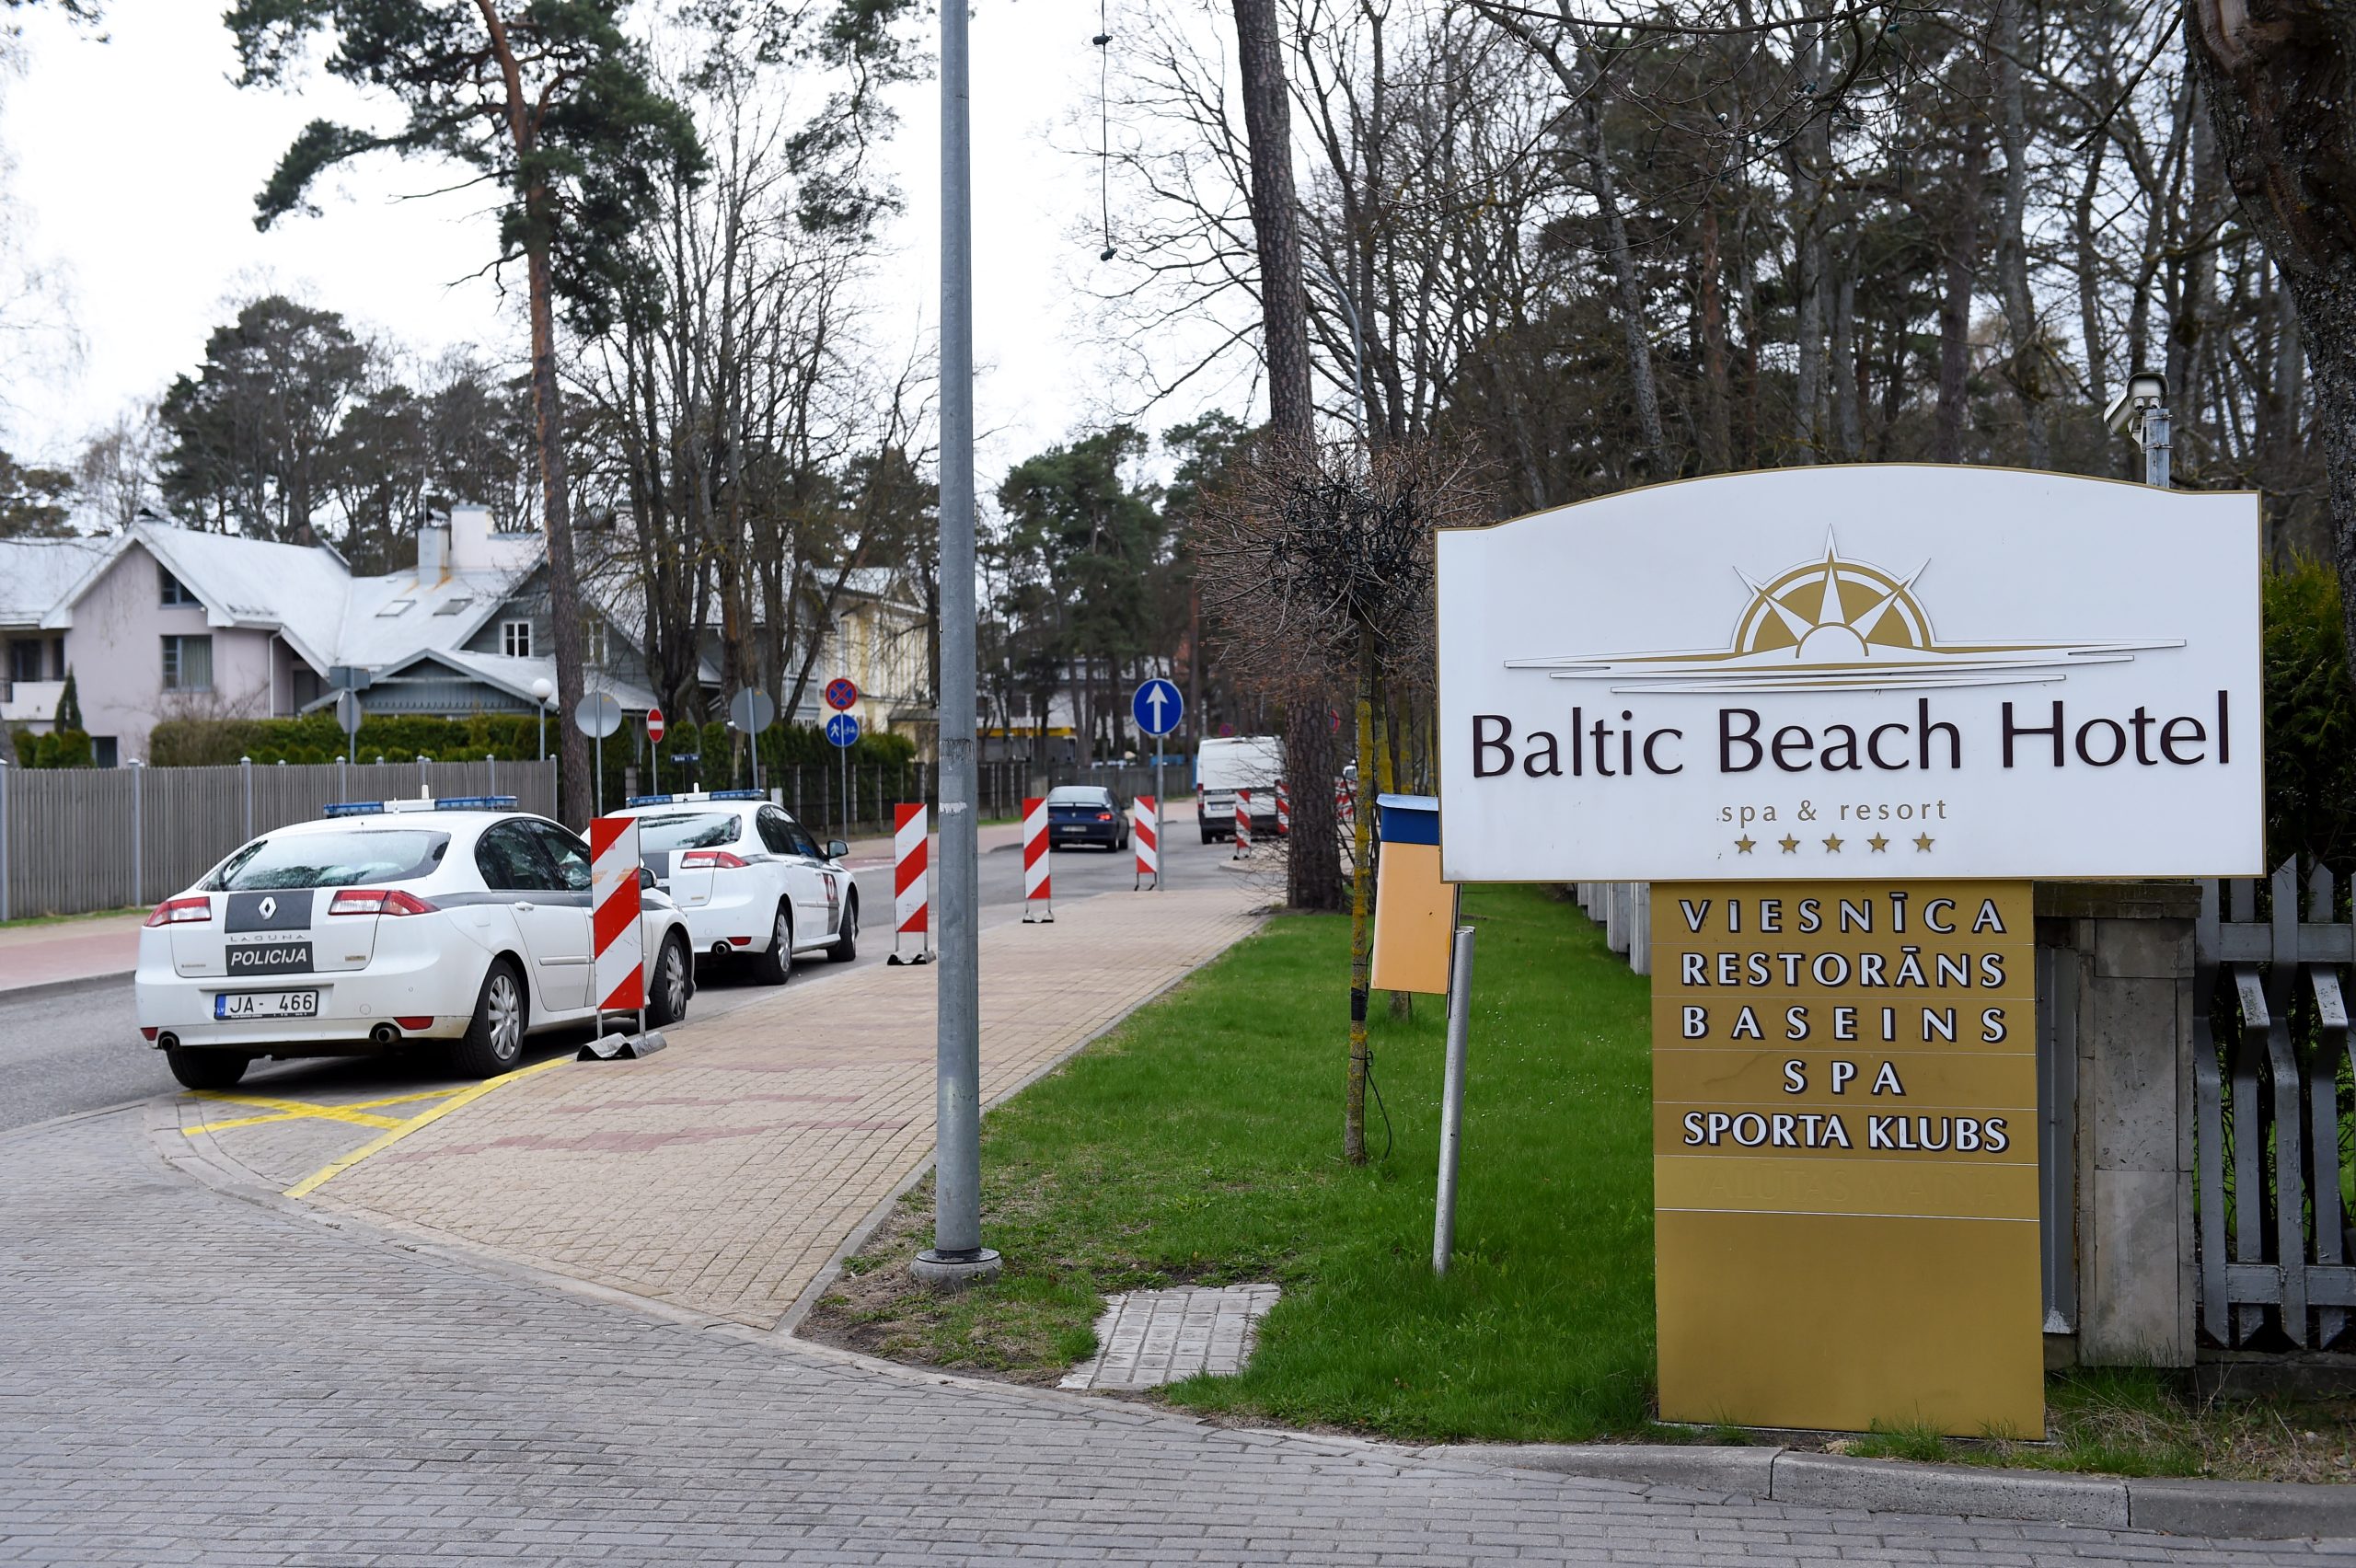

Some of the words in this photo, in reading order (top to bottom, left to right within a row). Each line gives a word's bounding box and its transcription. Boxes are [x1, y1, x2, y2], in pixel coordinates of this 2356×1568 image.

[1472, 706, 1683, 778] Baltic
[1718, 698, 1961, 773] Beach
[2002, 690, 2229, 767] Hotel
[1721, 805, 1777, 829] spa
[1797, 800, 1817, 822] &
[1840, 799, 1947, 821] resort
[1679, 892, 2007, 934] VIESNĪCA
[230, 934, 306, 942] LAGUNA
[231, 948, 307, 966] POLICIJA
[1681, 946, 2006, 988] RESTORĀNS
[279, 994, 313, 1011] 466
[1682, 1006, 2007, 1043] BASEINS
[1783, 1059, 1907, 1096] SPA
[1683, 1111, 1854, 1149] SPORTA
[1867, 1115, 2010, 1154] KLUBS
